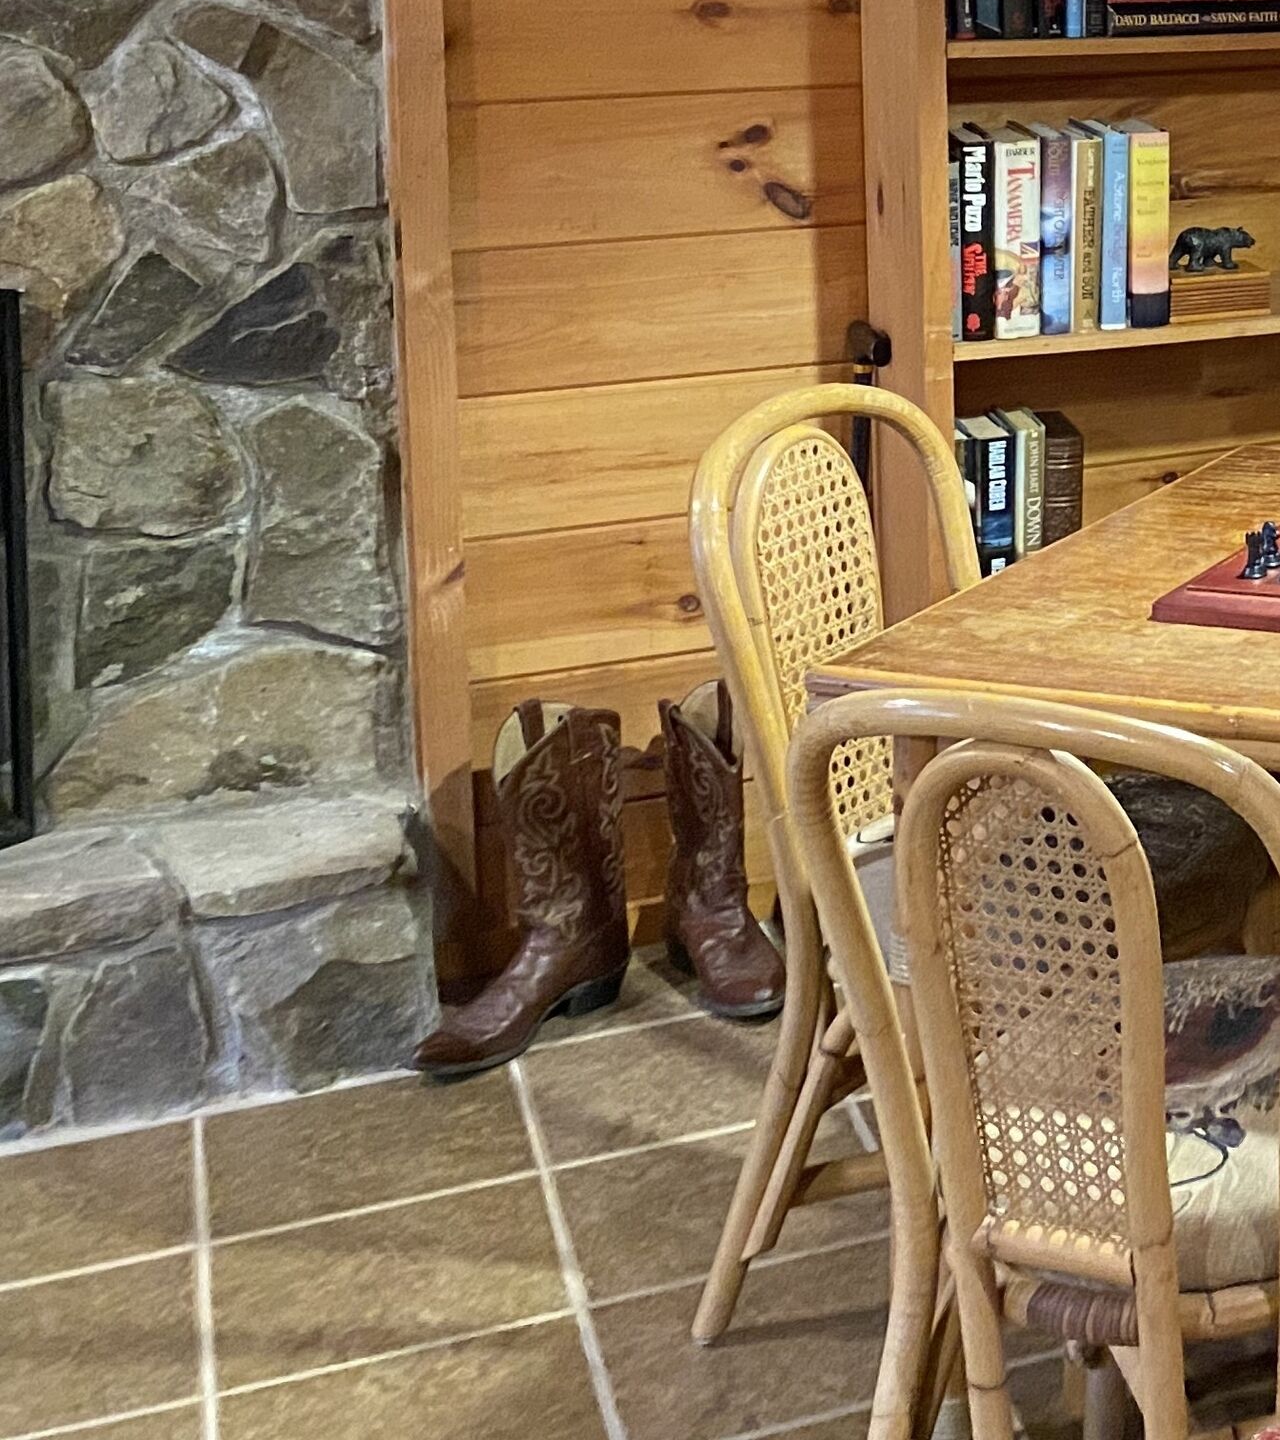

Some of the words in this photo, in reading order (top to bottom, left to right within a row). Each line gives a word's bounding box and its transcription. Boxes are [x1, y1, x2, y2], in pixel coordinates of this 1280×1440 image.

[1115, 14, 1147, 26] DAVID
[1149, 13, 1200, 25] BALDACCI
[1210, 12, 1246, 24] SAVING
[1248, 11, 1278, 22] FAITH
[963, 146, 987, 191] Mario
[963, 193, 986, 232] Puzo
[1005, 161, 1036, 245] TANAMERA
[1082, 189, 1096, 249] FATHER
[976, 253, 987, 275] THE
[1083, 252, 1093, 274] and
[1082, 276, 1095, 300] SON
[989, 440, 1007, 479] HARLAN
[1029, 440, 1039, 467] JOHN
[989, 480, 1006, 511] COBEN
[1029, 468, 1039, 494] HART
[1026, 496, 1041, 546] DOWN
